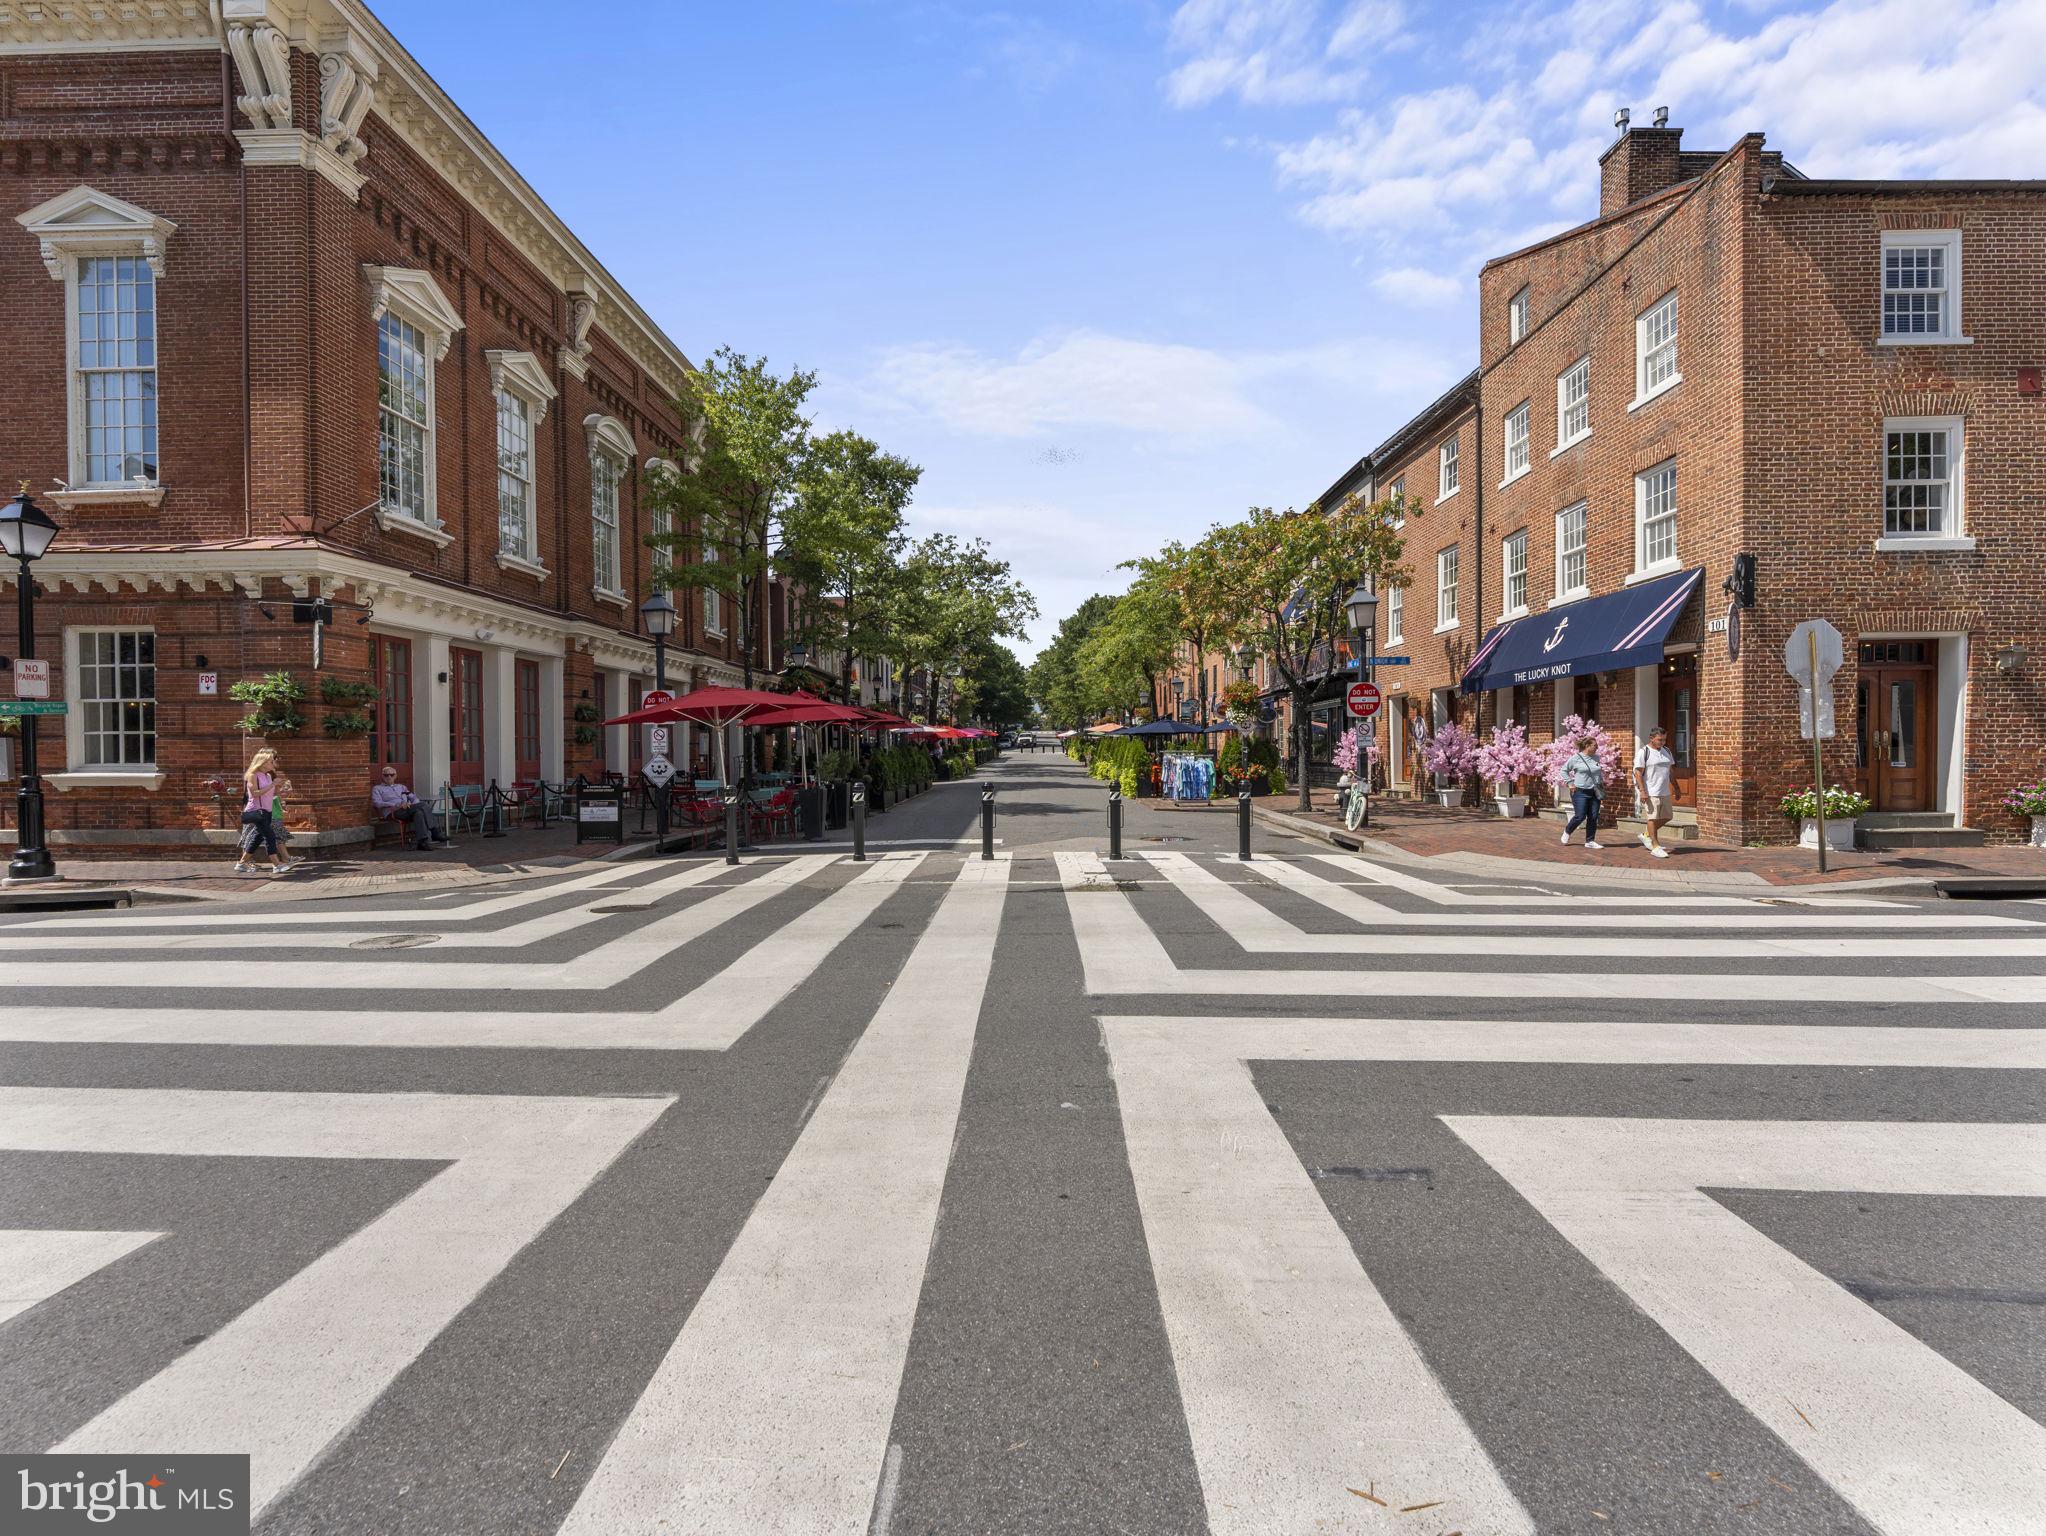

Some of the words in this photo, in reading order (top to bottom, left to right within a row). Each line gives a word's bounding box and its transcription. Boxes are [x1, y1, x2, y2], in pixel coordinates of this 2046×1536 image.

[1711, 620, 1725, 631] 101
[25, 664, 38, 673] NO
[1514, 671, 1527, 682] THE
[1528, 667, 1550, 680] LUCKY
[1551, 663, 1571, 676] KNOT
[18, 673, 46, 681] PARKING
[200, 675, 215, 683] FDC
[659, 696, 670, 704] NOT
[1354, 703, 1374, 711] ENTER
